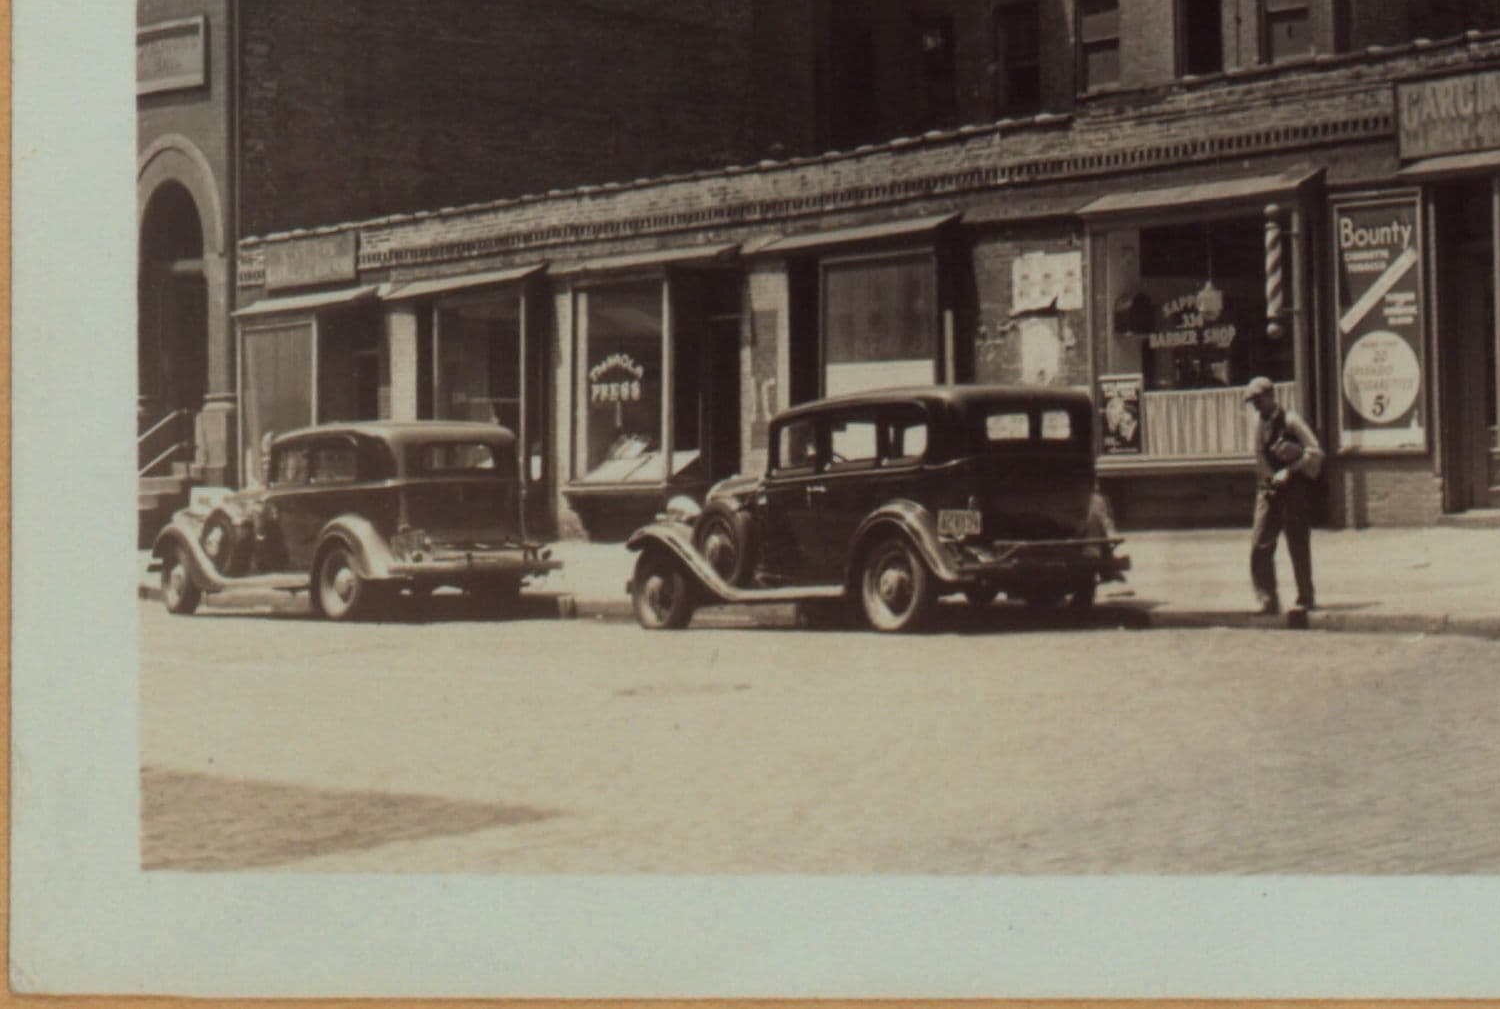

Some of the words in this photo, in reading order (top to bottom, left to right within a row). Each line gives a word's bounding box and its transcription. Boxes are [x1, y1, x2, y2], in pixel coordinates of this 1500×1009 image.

[1340, 217, 1412, 249] Bounty
[1203, 324, 1236, 348] SHOP
[592, 380, 641, 403] PRESS
